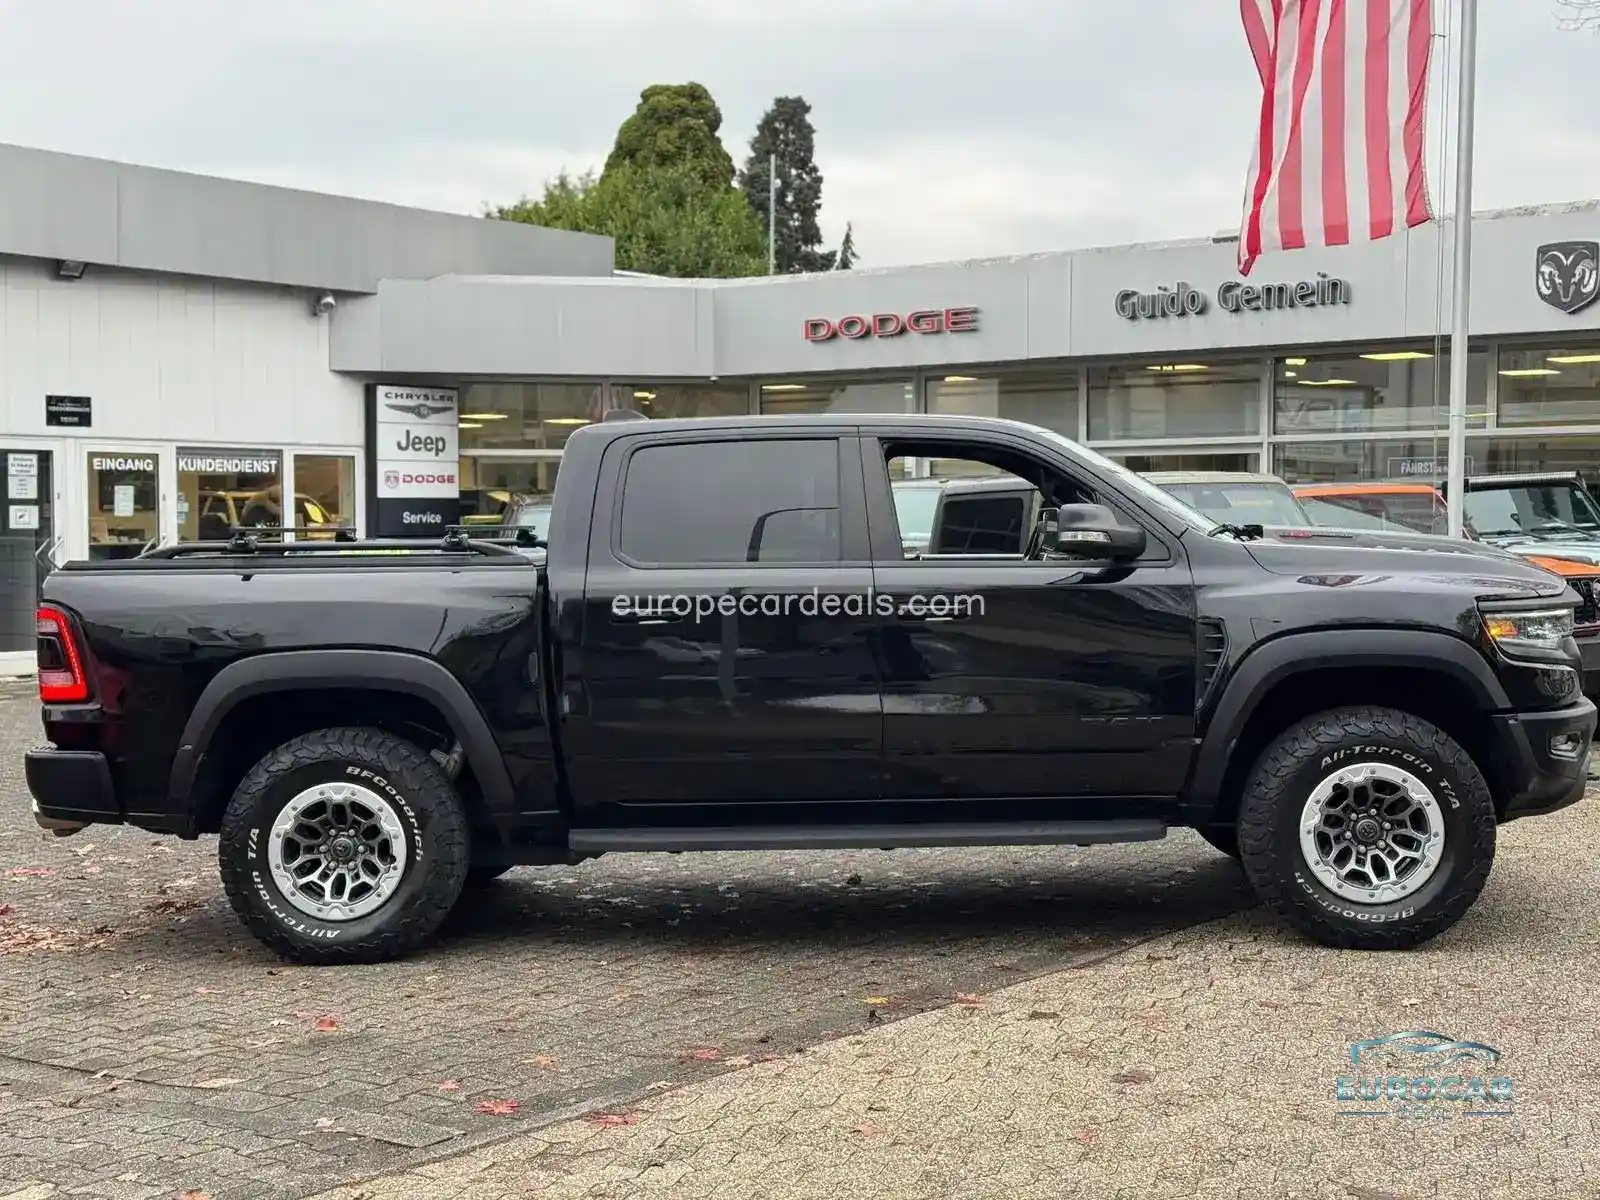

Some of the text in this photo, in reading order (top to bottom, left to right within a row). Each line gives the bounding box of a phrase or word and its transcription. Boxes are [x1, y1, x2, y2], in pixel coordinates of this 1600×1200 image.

[1115, 271, 1351, 319] Guido Gemein
[804, 305, 980, 342] DODGE
[384, 391, 454, 402] CHRYSLER
[396, 429, 446, 457] Jeep
[93, 457, 153, 471] EINGANG
[178, 457, 277, 473] KUNDENDIENST
[402, 474, 455, 484] DODGE
[402, 511, 442, 524] Service
[1320, 744, 1461, 810] All-Terrain T/A
[346, 765, 425, 862] BFGoodrich
[247, 827, 341, 939] All-Terrain T/A
[1294, 871, 1416, 923] BFGoodrich
